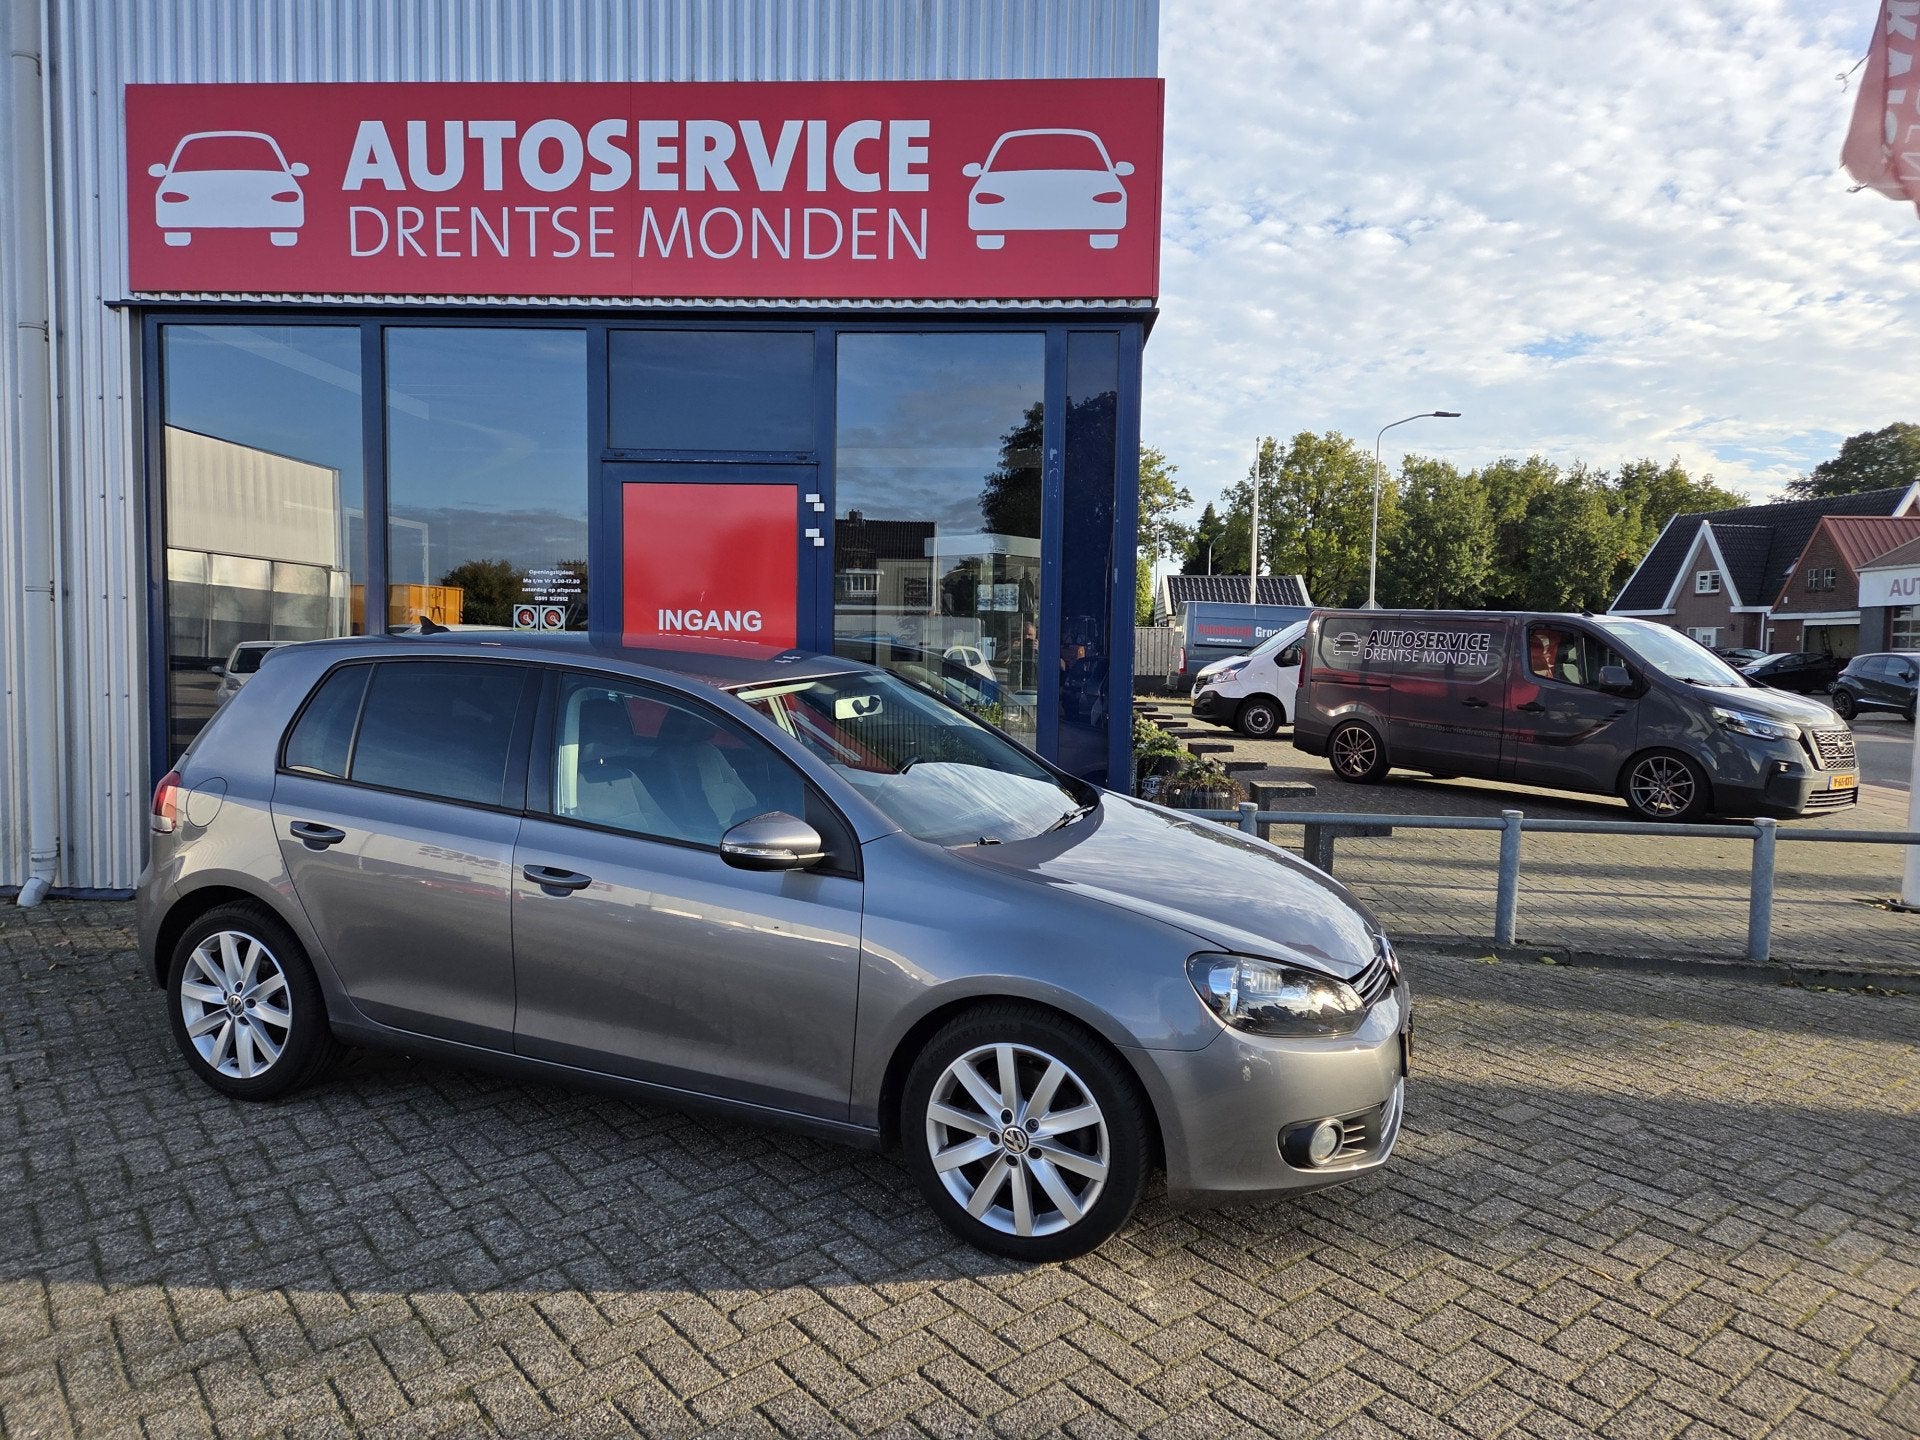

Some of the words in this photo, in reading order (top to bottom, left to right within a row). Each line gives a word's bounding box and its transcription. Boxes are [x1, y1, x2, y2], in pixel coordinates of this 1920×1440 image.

[341, 118, 931, 193] AUTOSERVICE
[349, 205, 615, 258] DRENTSE
[637, 206, 928, 260] MONDEN
[658, 609, 762, 632] INGANG
[1255, 626, 1282, 638] Gro
[1365, 629, 1491, 652] AUTOSERVICE
[1364, 647, 1420, 663] DRENTSE
[1422, 650, 1489, 667] MONDEN
